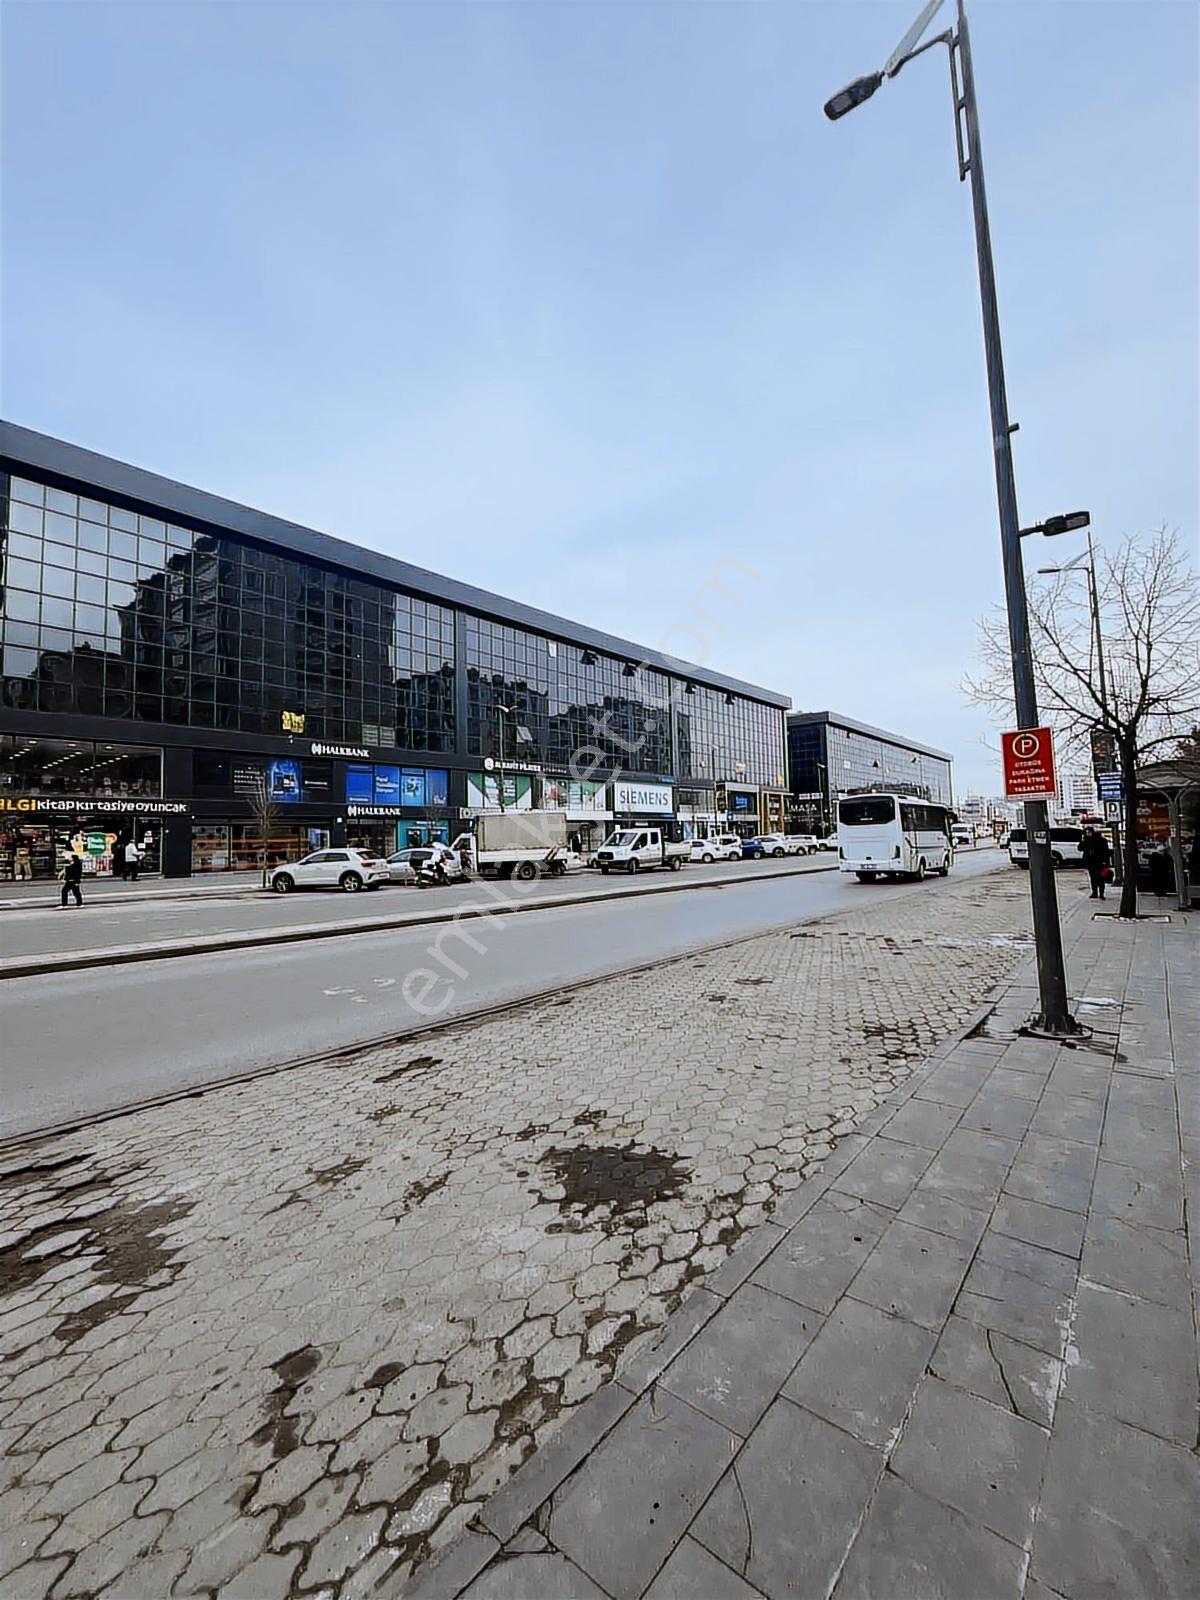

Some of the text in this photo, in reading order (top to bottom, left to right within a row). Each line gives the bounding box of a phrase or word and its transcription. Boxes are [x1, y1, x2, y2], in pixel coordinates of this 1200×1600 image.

[322, 744, 371, 758] HALKBANK
[1021, 739, 1033, 754] P
[619, 789, 669, 806] SIEMENS
[37, 799, 75, 811] kitap
[135, 801, 188, 813] oyuncak
[357, 806, 402, 816] HALKBANK
